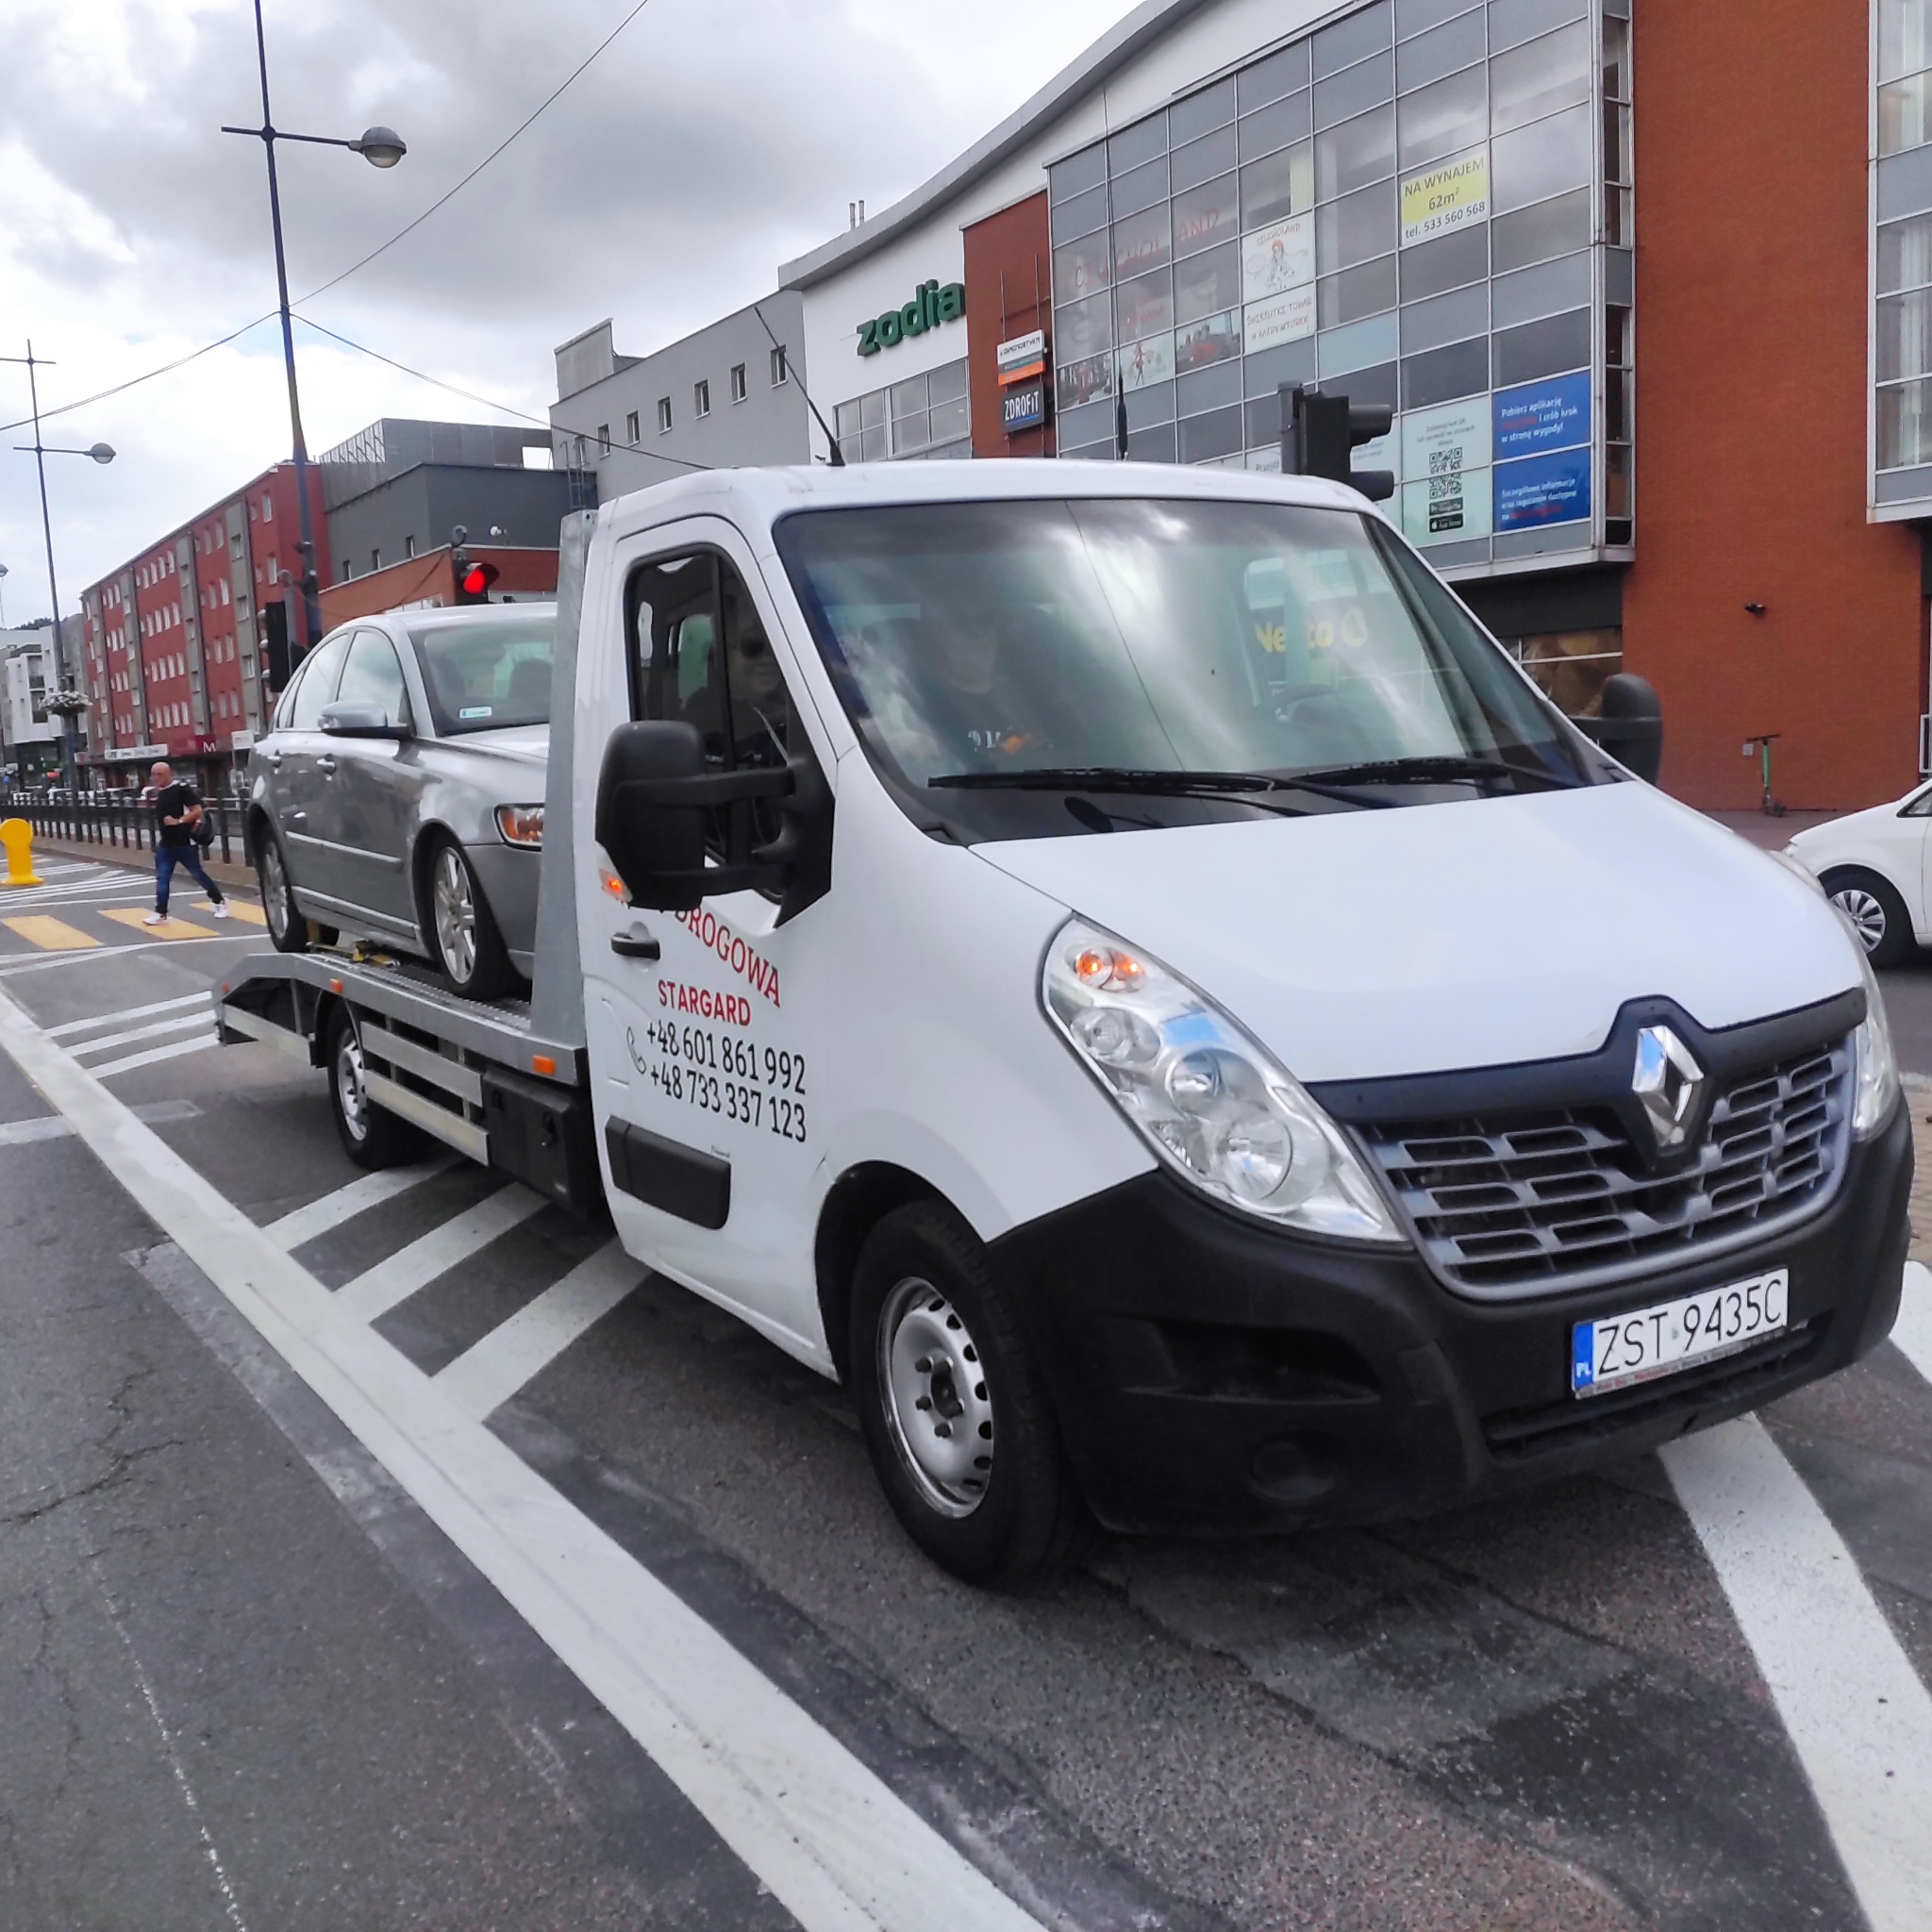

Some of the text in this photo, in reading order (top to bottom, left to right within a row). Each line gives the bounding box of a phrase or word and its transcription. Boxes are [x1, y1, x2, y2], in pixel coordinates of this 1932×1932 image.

[1405, 158, 1484, 198] NA WYNAJEM
[1405, 201, 1486, 239] tel. 533 560 568
[1502, 406, 1528, 417] Pobierz
[1560, 406, 1578, 417] krok
[658, 979, 751, 1026] STARGARD
[647, 1019, 806, 1095] +48 601 861 992
[650, 1062, 807, 1142] +48 733 337 123
[1598, 1311, 1668, 1374] ZST
[1683, 1279, 1781, 1353] 9435C
